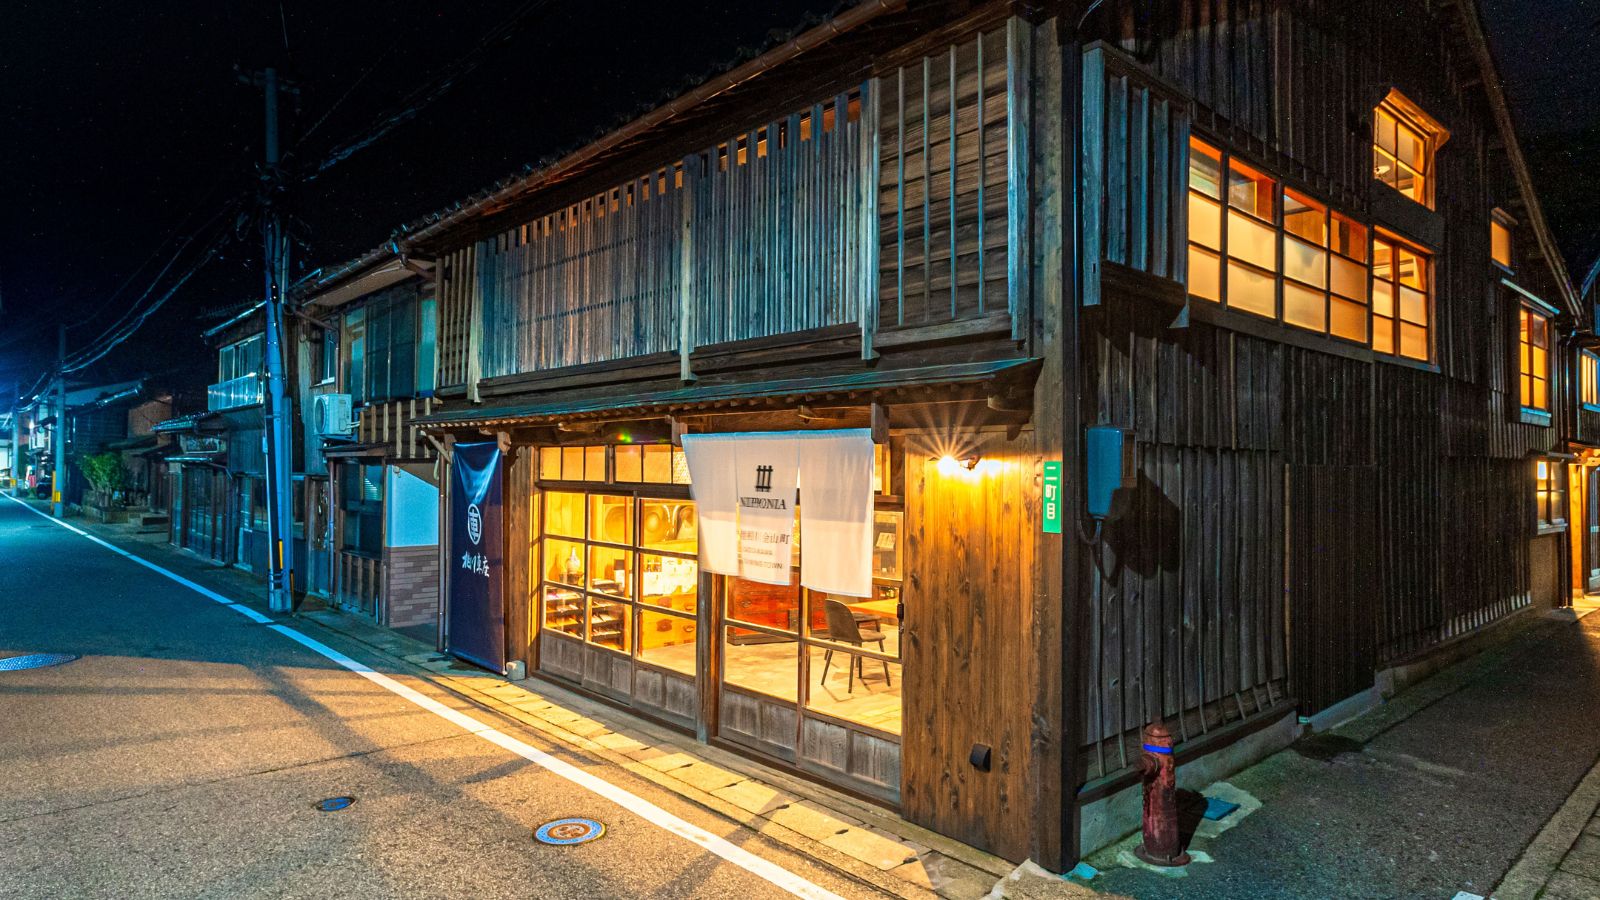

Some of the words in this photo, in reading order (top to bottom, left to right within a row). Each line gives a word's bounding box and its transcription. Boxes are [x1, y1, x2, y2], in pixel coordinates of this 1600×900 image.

[740, 497, 786, 509] NIPPONIA
[1045, 466, 1057, 519] 二町目
